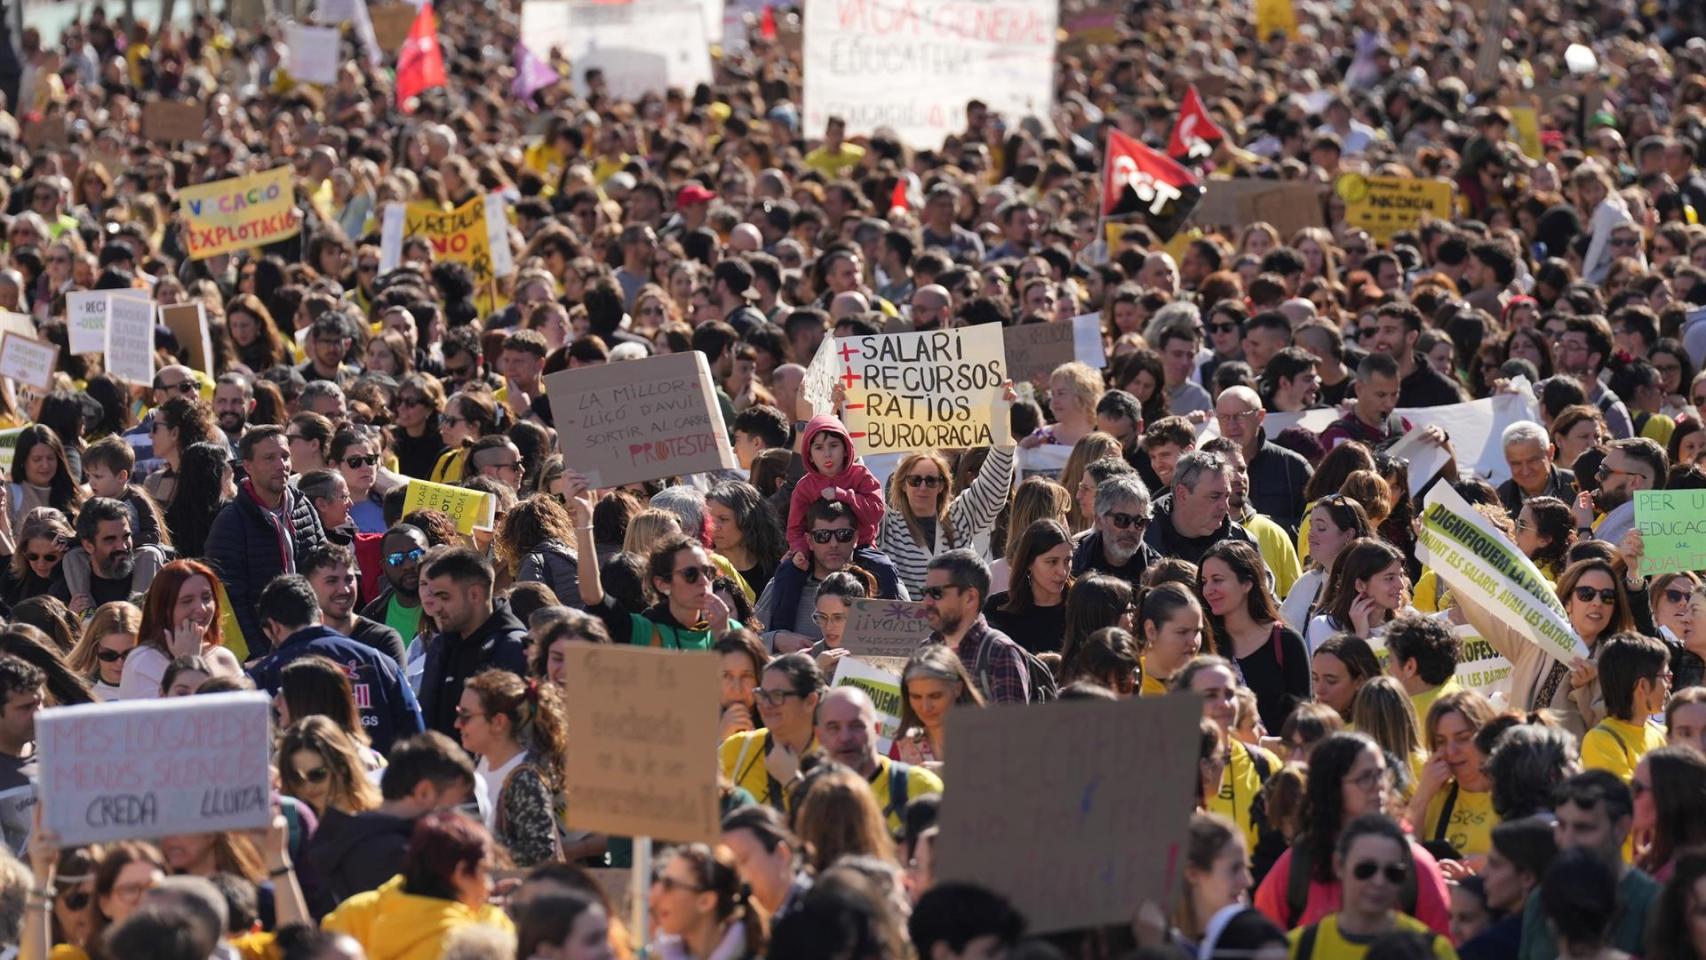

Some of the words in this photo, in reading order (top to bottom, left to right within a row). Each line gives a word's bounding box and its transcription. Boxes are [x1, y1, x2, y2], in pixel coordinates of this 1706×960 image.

[430, 233, 467, 255] NO
[863, 360, 1002, 393] RECURSOS
[578, 392, 603, 410] LA
[651, 420, 670, 433] AL
[1639, 493, 1675, 512] PER
[1430, 503, 1511, 572] DIGNIFIQUEM
[1508, 562, 1524, 584] LA
[1445, 550, 1464, 569] ELS
[1524, 607, 1541, 627] LES
[86, 791, 159, 829] CREDA
